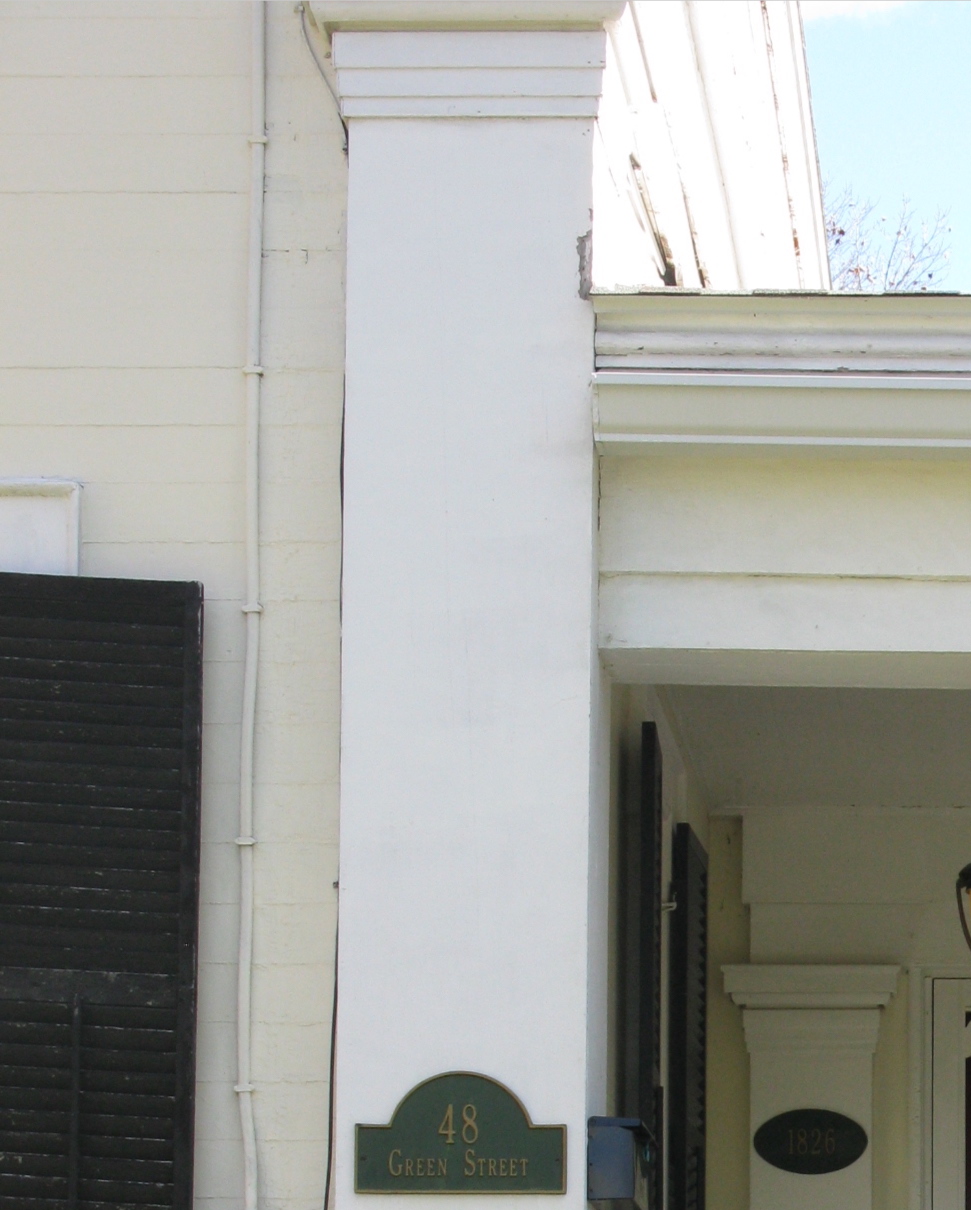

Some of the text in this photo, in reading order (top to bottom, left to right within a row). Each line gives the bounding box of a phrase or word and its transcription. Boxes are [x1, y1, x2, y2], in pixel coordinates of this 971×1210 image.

[438, 1103, 479, 1144] 48
[788, 1128, 835, 1155] 1826
[388, 1149, 529, 1177] GREEN STREET
